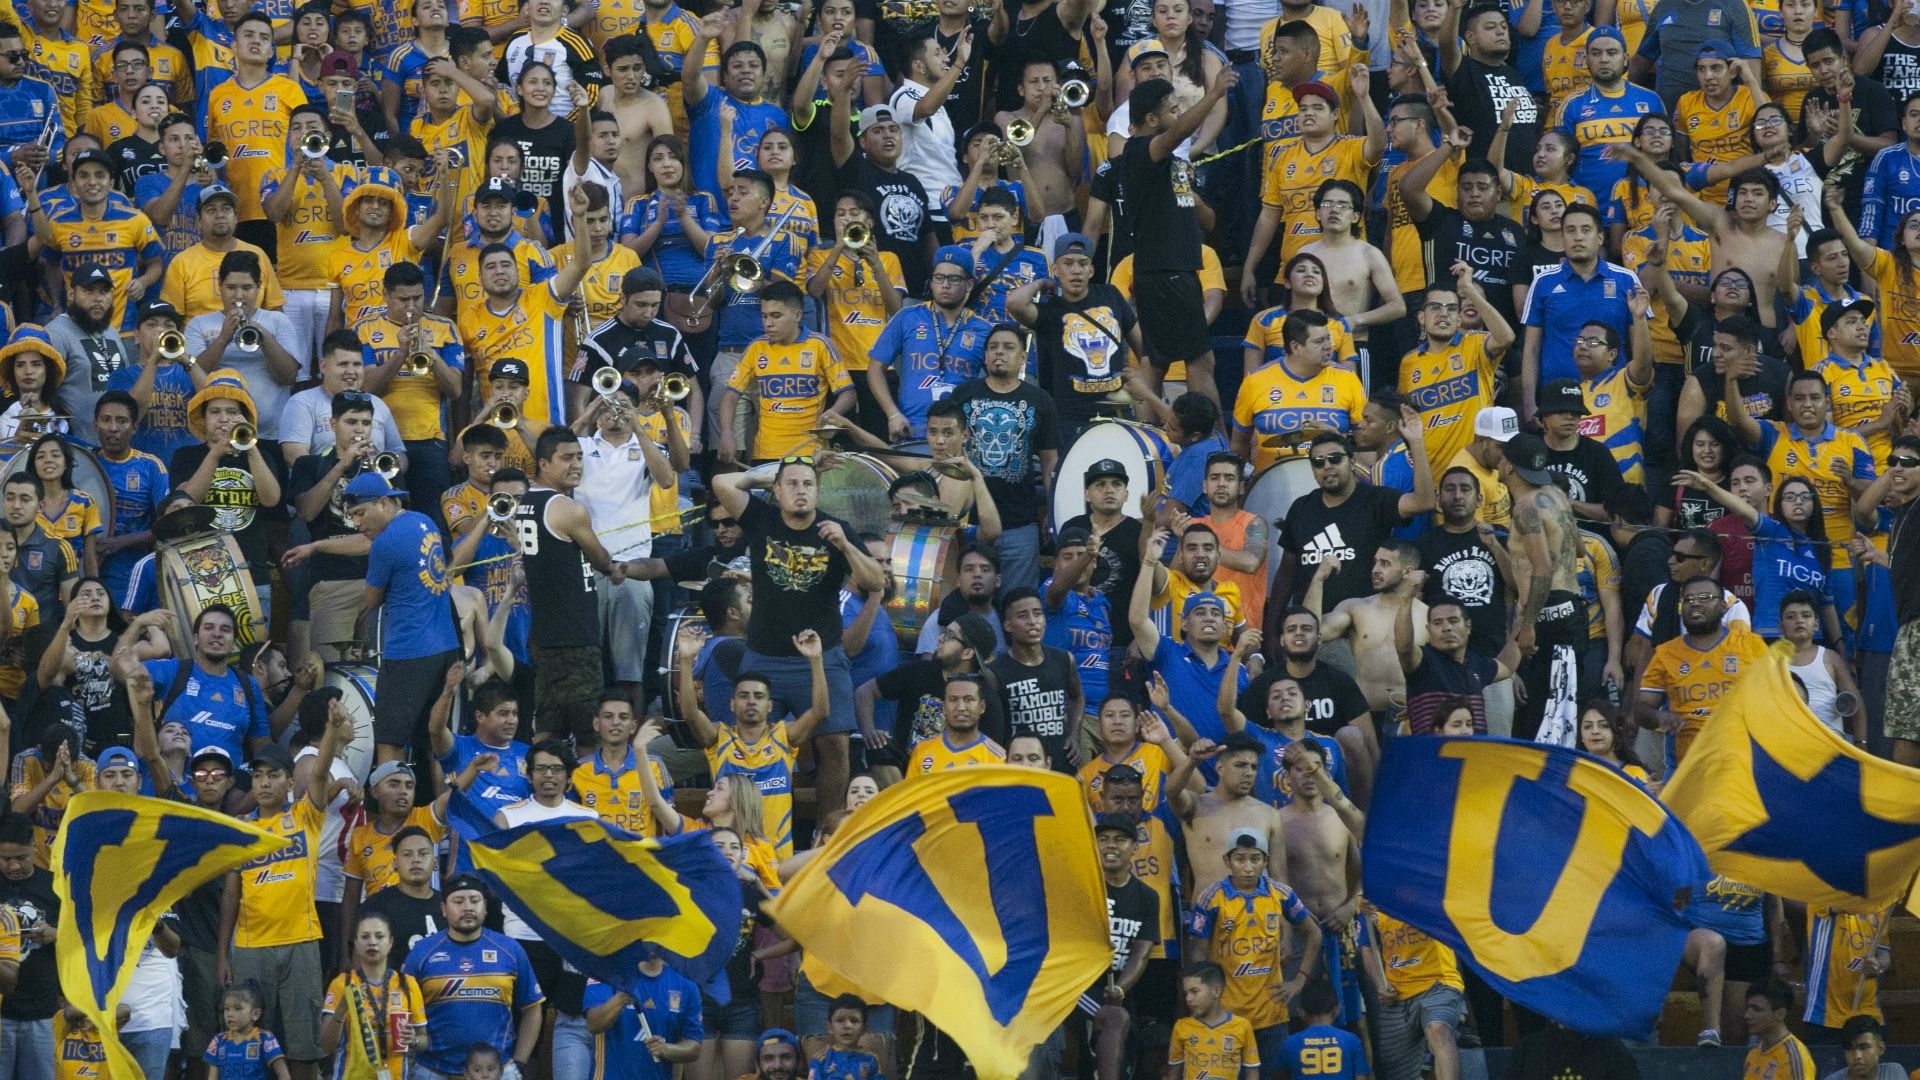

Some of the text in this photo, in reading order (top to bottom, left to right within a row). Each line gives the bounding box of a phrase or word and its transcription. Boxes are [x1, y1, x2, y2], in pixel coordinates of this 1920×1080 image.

[1883, 54, 1917, 66] THE
[217, 120, 284, 138] TIGRES
[525, 156, 561, 171] OUS
[757, 377, 816, 397] TIGRES
[1263, 411, 1341, 430] TIGRES
[1301, 546, 1356, 565] adidas
[1006, 678, 1039, 698] THE
[1008, 690, 1064, 711] FAMOUS
[457, 986, 501, 997] CEMEX
[1299, 1047, 1342, 1074] 98
